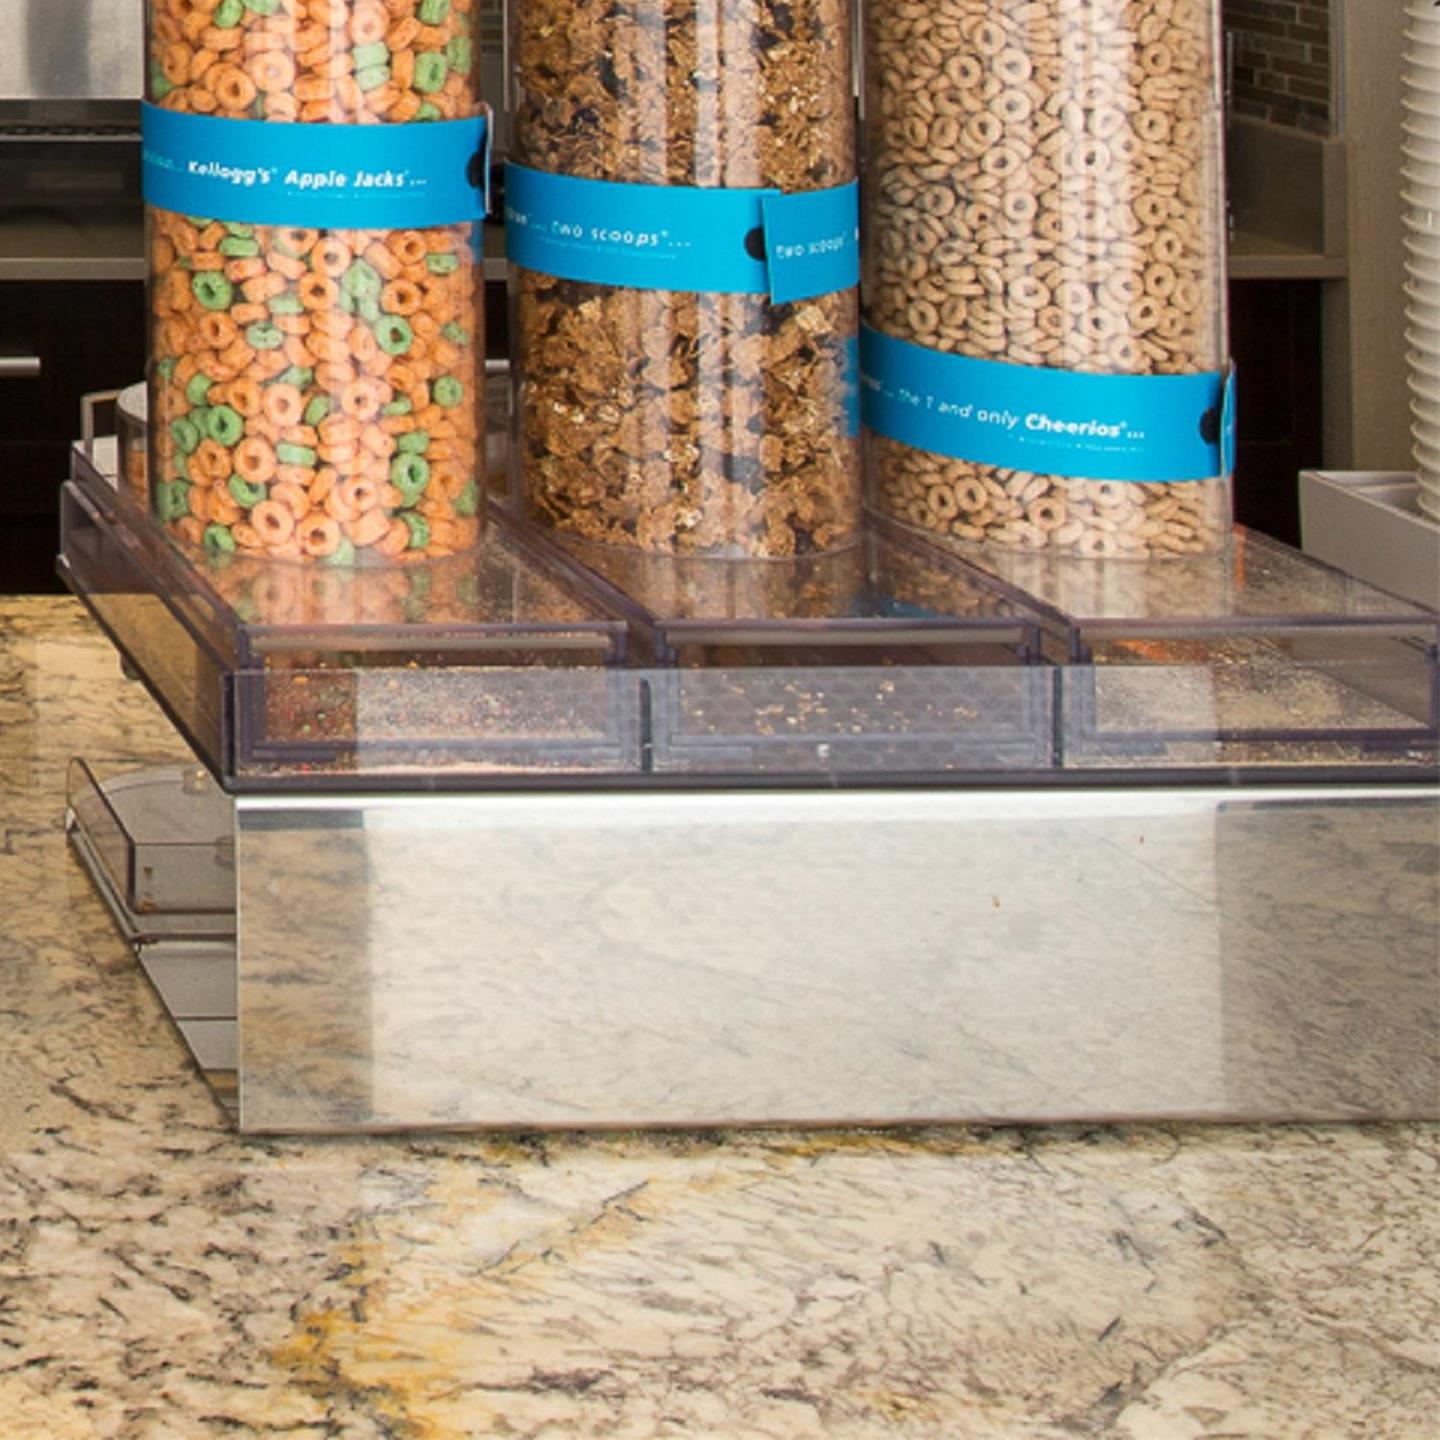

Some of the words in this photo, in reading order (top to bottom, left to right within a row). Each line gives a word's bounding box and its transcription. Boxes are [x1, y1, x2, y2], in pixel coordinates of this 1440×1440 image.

[284, 170, 347, 190] Apple
[938, 402, 973, 417] and
[977, 409, 1019, 431] only
